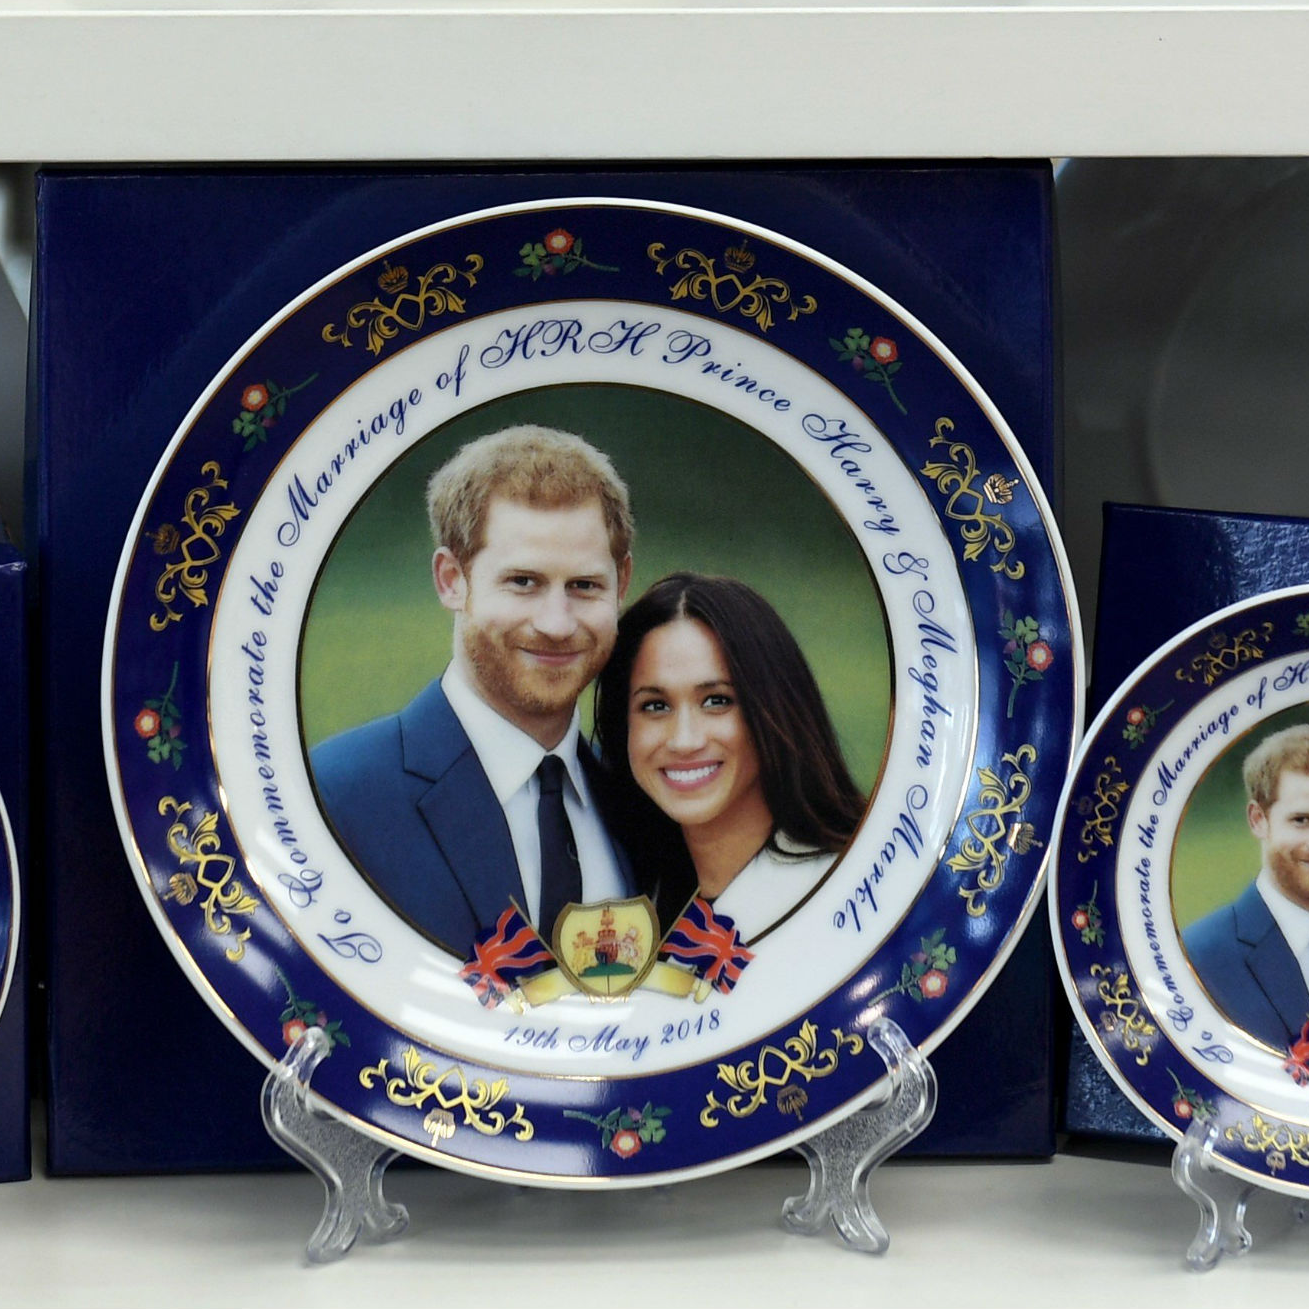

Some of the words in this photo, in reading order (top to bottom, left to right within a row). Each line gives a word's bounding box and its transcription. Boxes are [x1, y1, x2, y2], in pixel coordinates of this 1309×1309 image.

[435, 343, 471, 398] of
[479, 318, 662, 370] HRH
[661, 329, 792, 412] Prince
[276, 387, 423, 548] Marriage
[801, 413, 901, 537] Harry
[249, 561, 285, 617] the
[883, 551, 930, 582] &
[911, 589, 958, 769] Meghan
[1246, 676, 1268, 710] of
[240, 630, 324, 909] Commemorate
[1152, 704, 1240, 807] Marriage
[832, 784, 929, 933] Markle
[1137, 814, 1160, 849] the
[316, 908, 383, 964] To
[1136, 858, 1195, 1032] Commemorate
[503, 1026, 560, 1050] 19th
[568, 1024, 650, 1061] May
[660, 1008, 721, 1045] 2018
[1191, 1030, 1235, 1065] To
